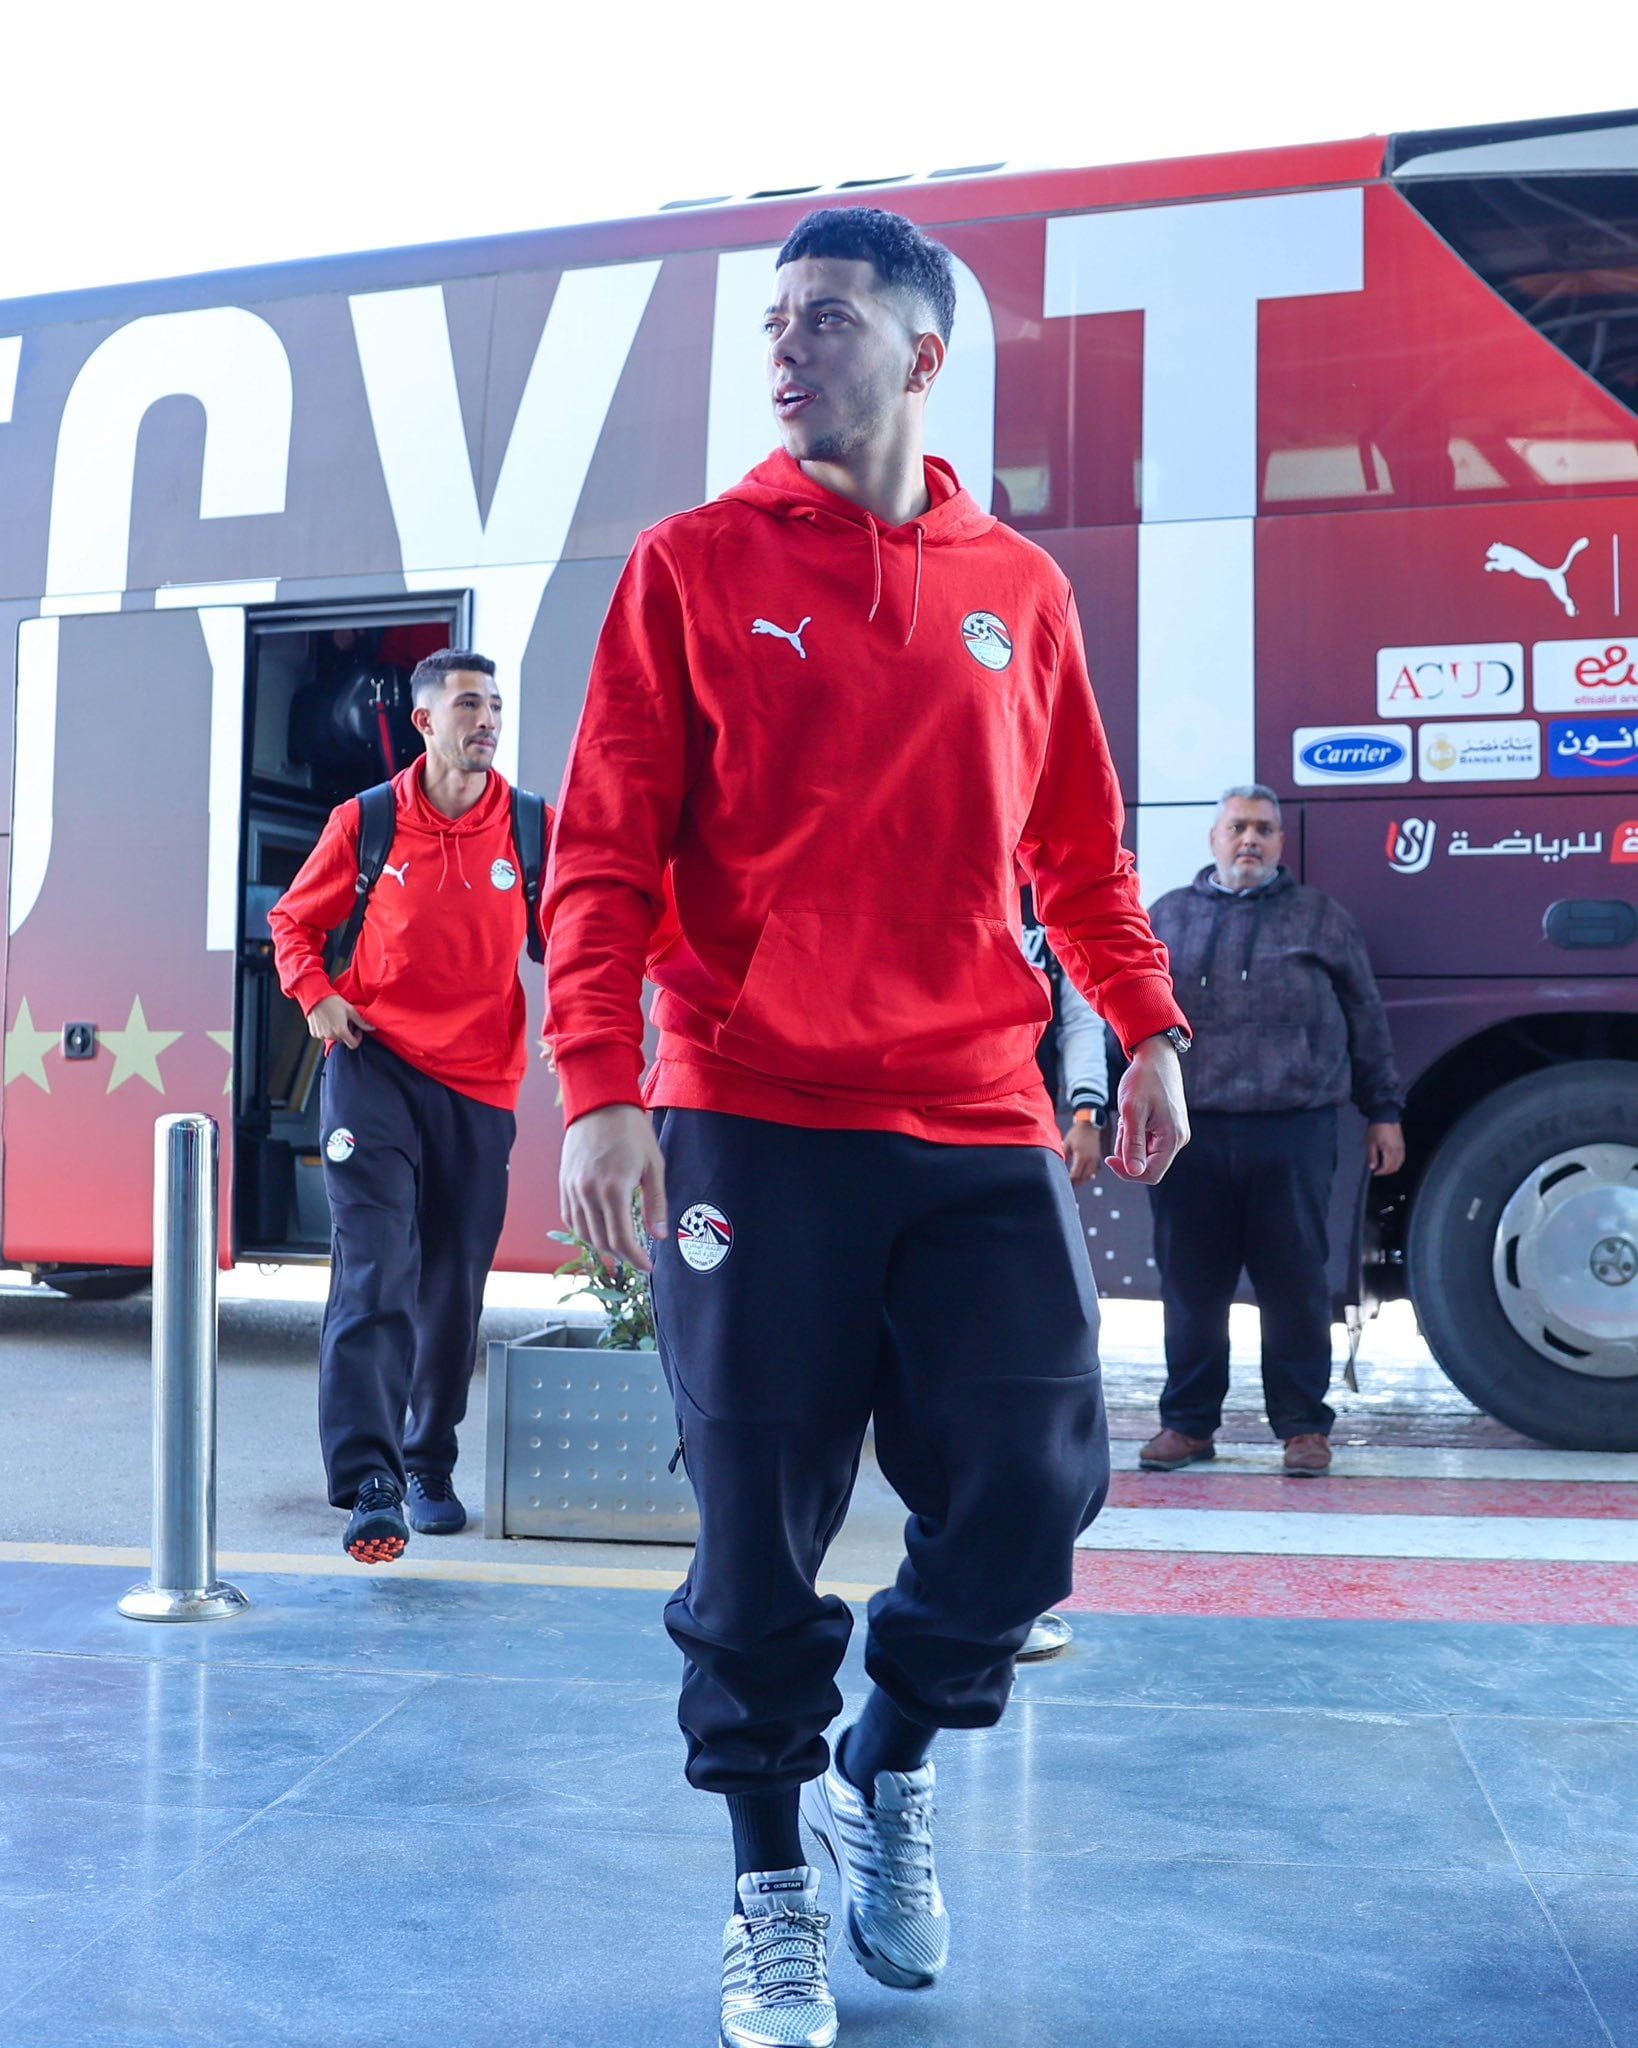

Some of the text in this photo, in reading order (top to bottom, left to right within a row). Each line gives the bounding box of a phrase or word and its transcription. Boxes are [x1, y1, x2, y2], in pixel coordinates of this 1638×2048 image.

[1388, 660, 1515, 700] ACUD
[1313, 743, 1392, 765] Carrier
[1448, 829, 1602, 863] للرياضة
